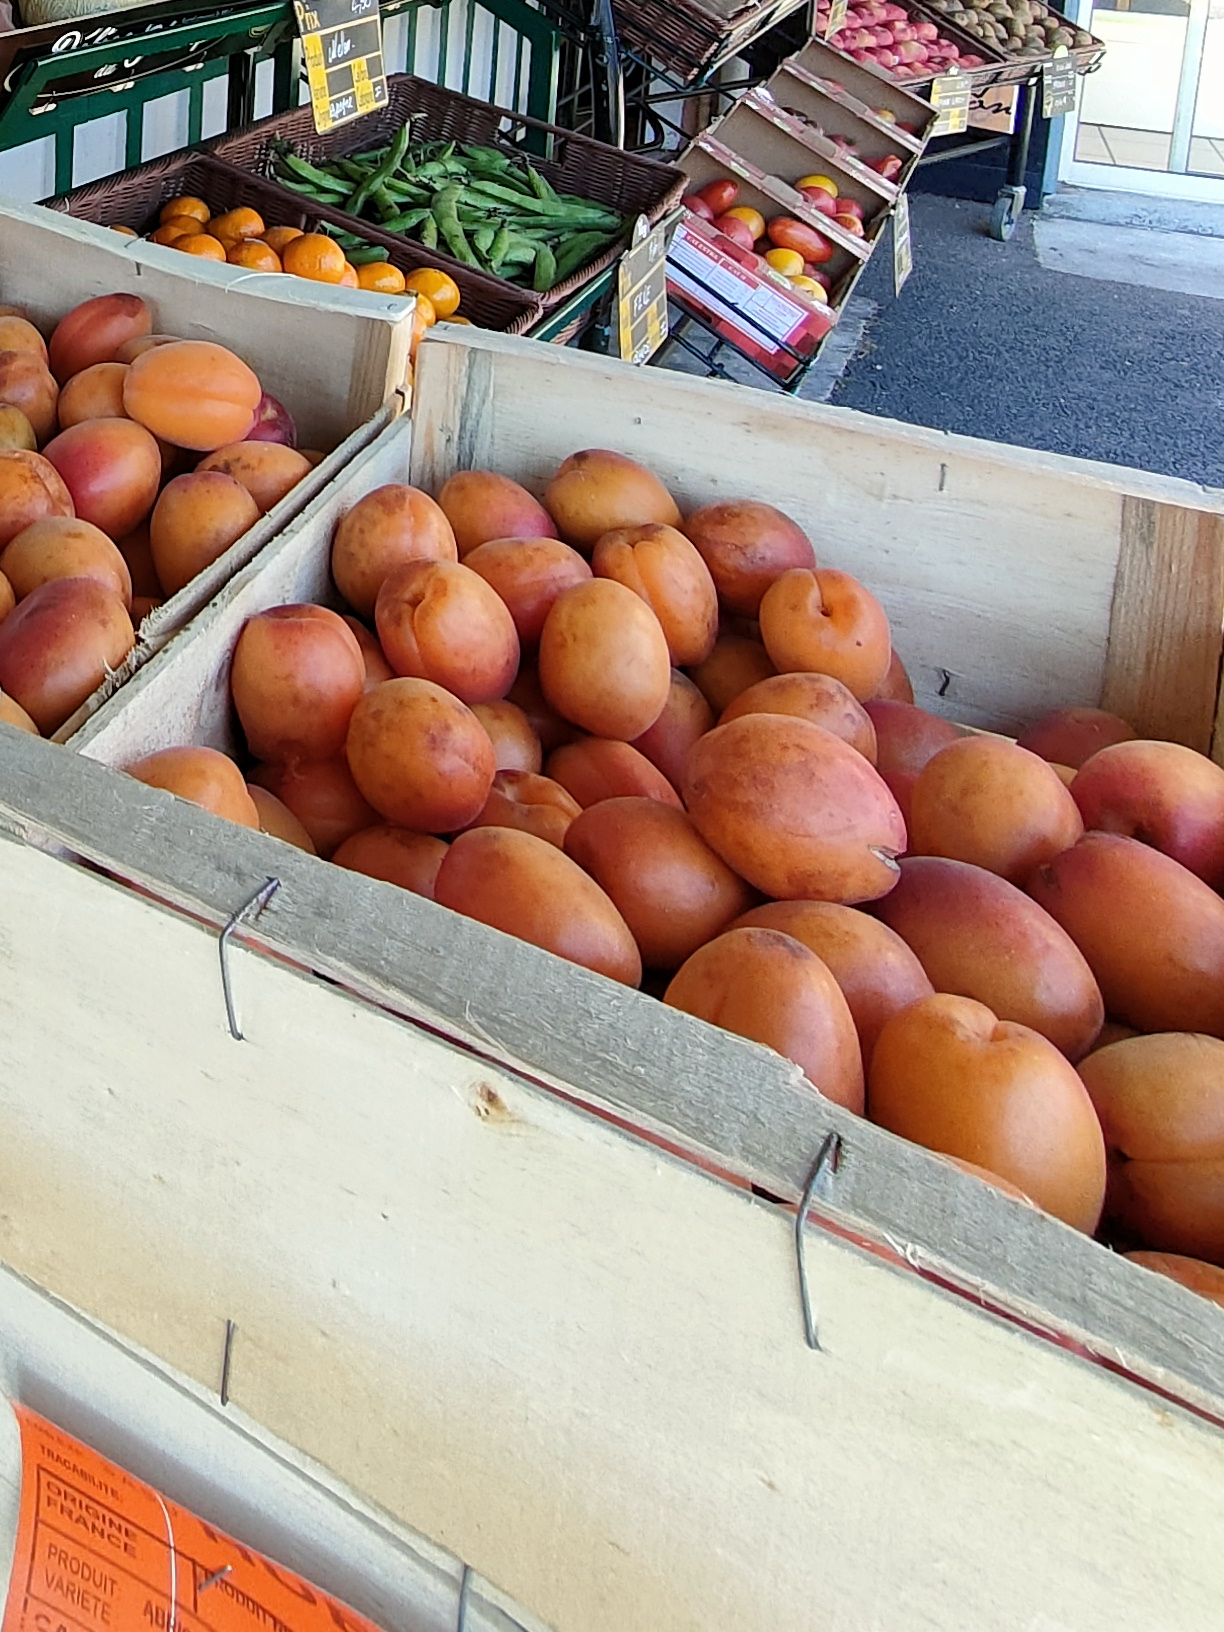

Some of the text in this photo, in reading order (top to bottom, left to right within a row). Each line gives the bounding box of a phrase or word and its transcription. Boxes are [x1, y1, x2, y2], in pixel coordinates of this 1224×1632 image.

[294, 0, 321, 32] Prix
[45, 1481, 139, 1542] ORIGINE
[45, 1495, 137, 1559] FRANCE
[43, 1570, 112, 1626] VARIETE
[48, 1542, 119, 1599] PRODUIT
